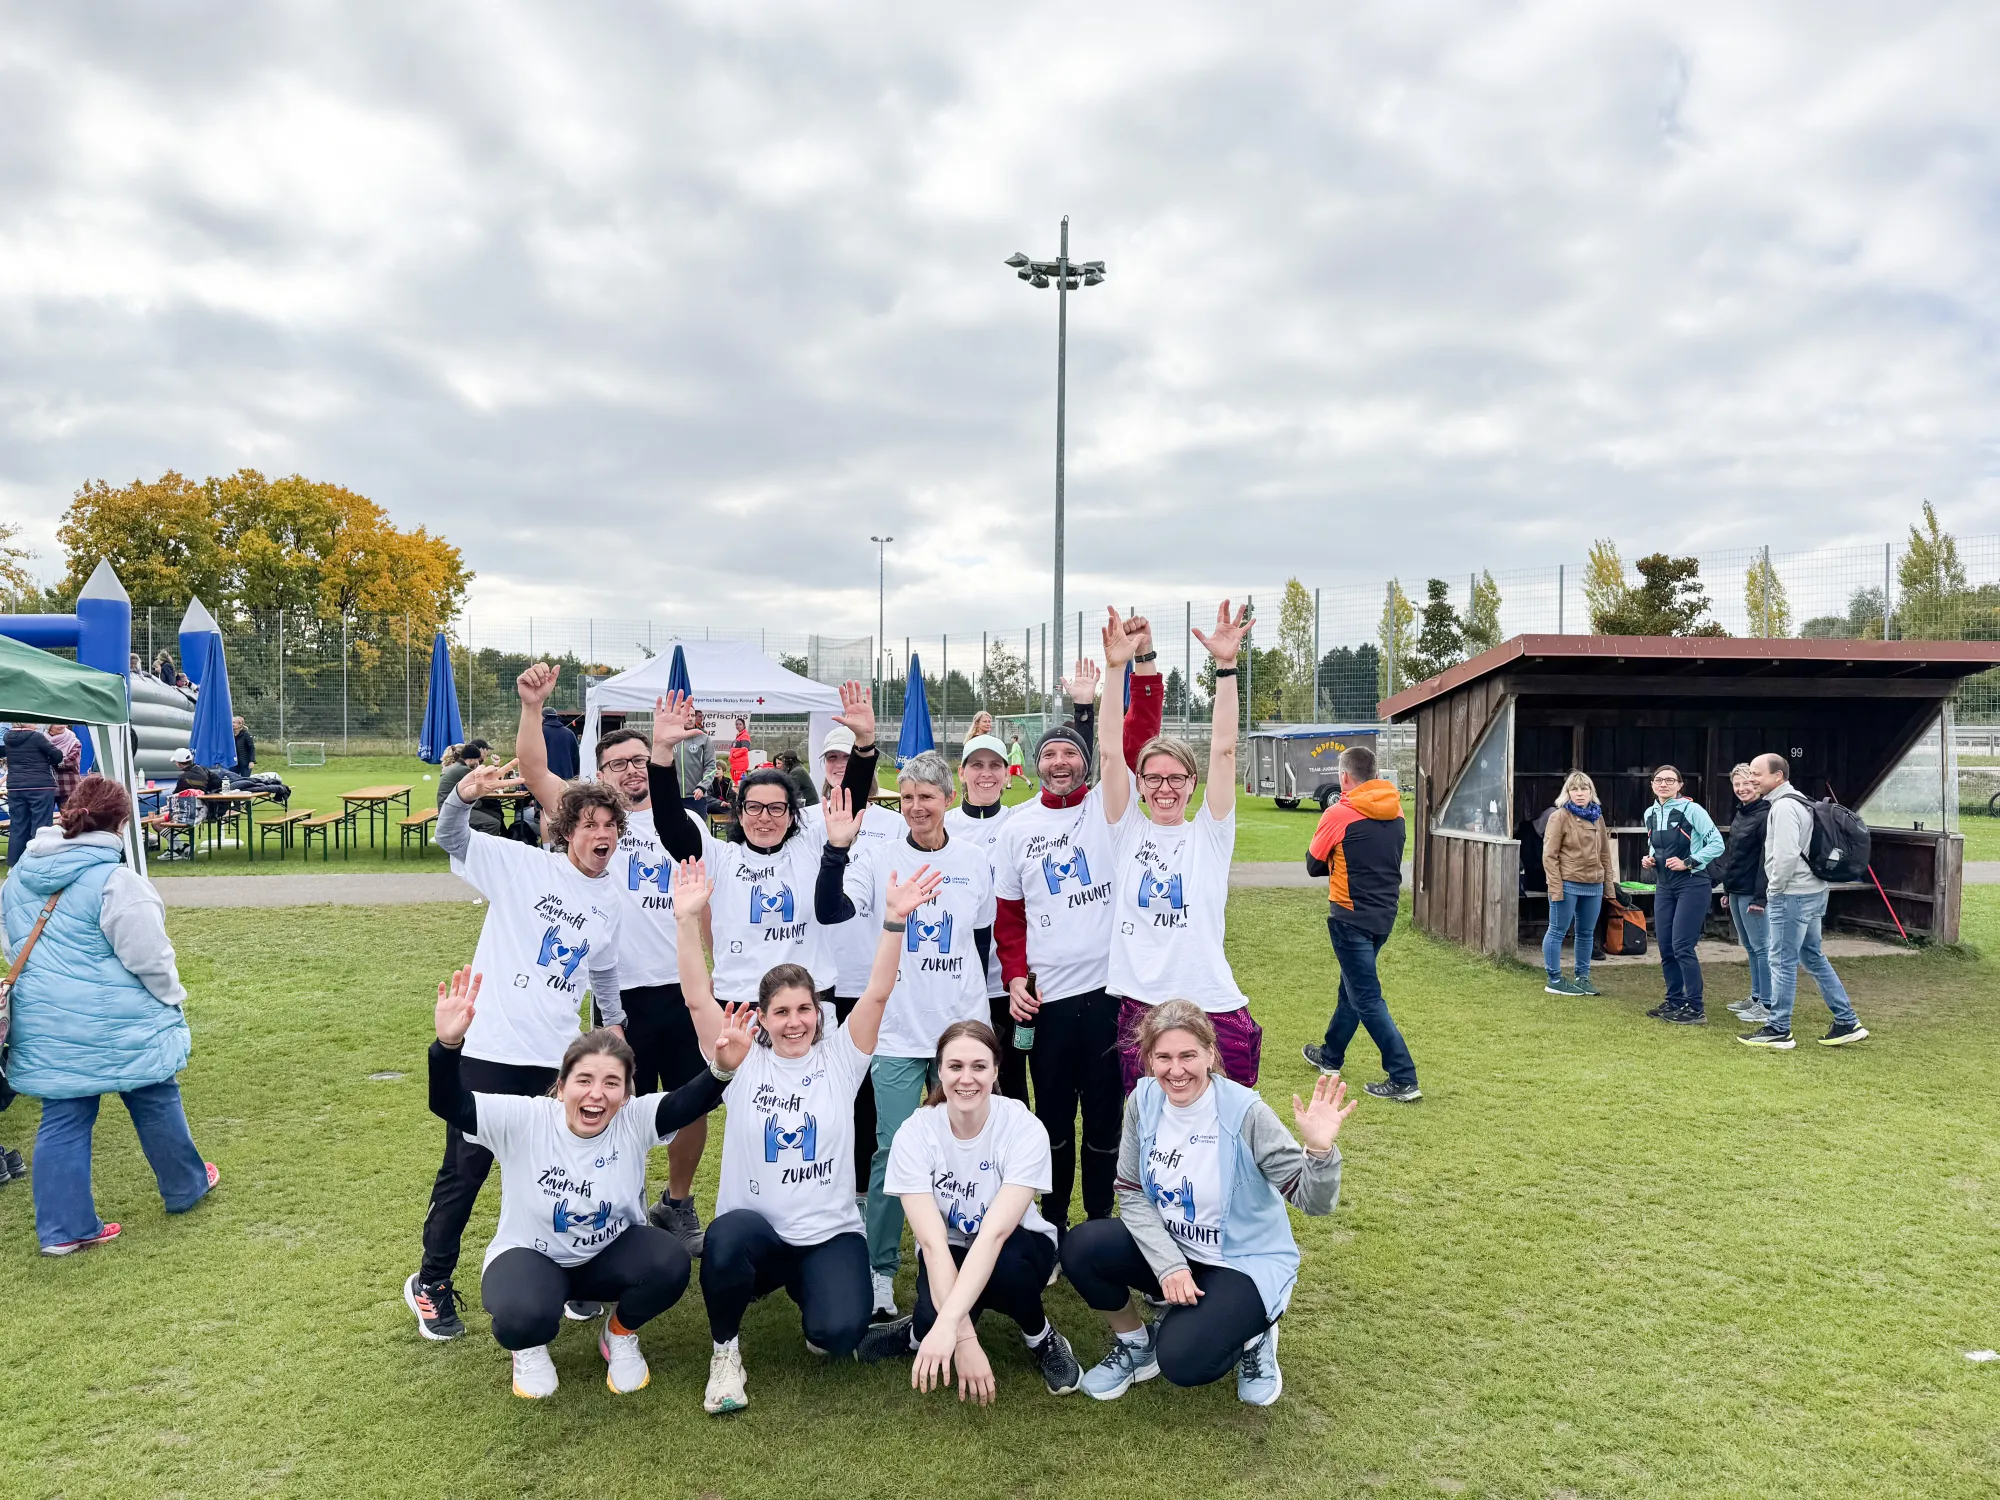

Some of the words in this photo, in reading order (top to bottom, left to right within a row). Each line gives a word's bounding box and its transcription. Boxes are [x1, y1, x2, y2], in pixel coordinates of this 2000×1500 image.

[702, 712, 749, 720] yerisches
[1790, 747, 1803, 758] 99
[1031, 835, 1045, 844] Wo
[547, 893, 563, 906] Wo
[1067, 881, 1112, 909] ZUKUNFT
[641, 896, 675, 910] ZUKUN
[539, 911, 556, 924] eine
[921, 956, 963, 972] ZUKUNFT
[1148, 1148, 1185, 1169] ersicht
[550, 1165, 566, 1177] Wo
[781, 1158, 835, 1185] ZUKUNFT
[543, 1187, 561, 1199] eine
[1166, 1218, 1221, 1245] ZUKUNFT
